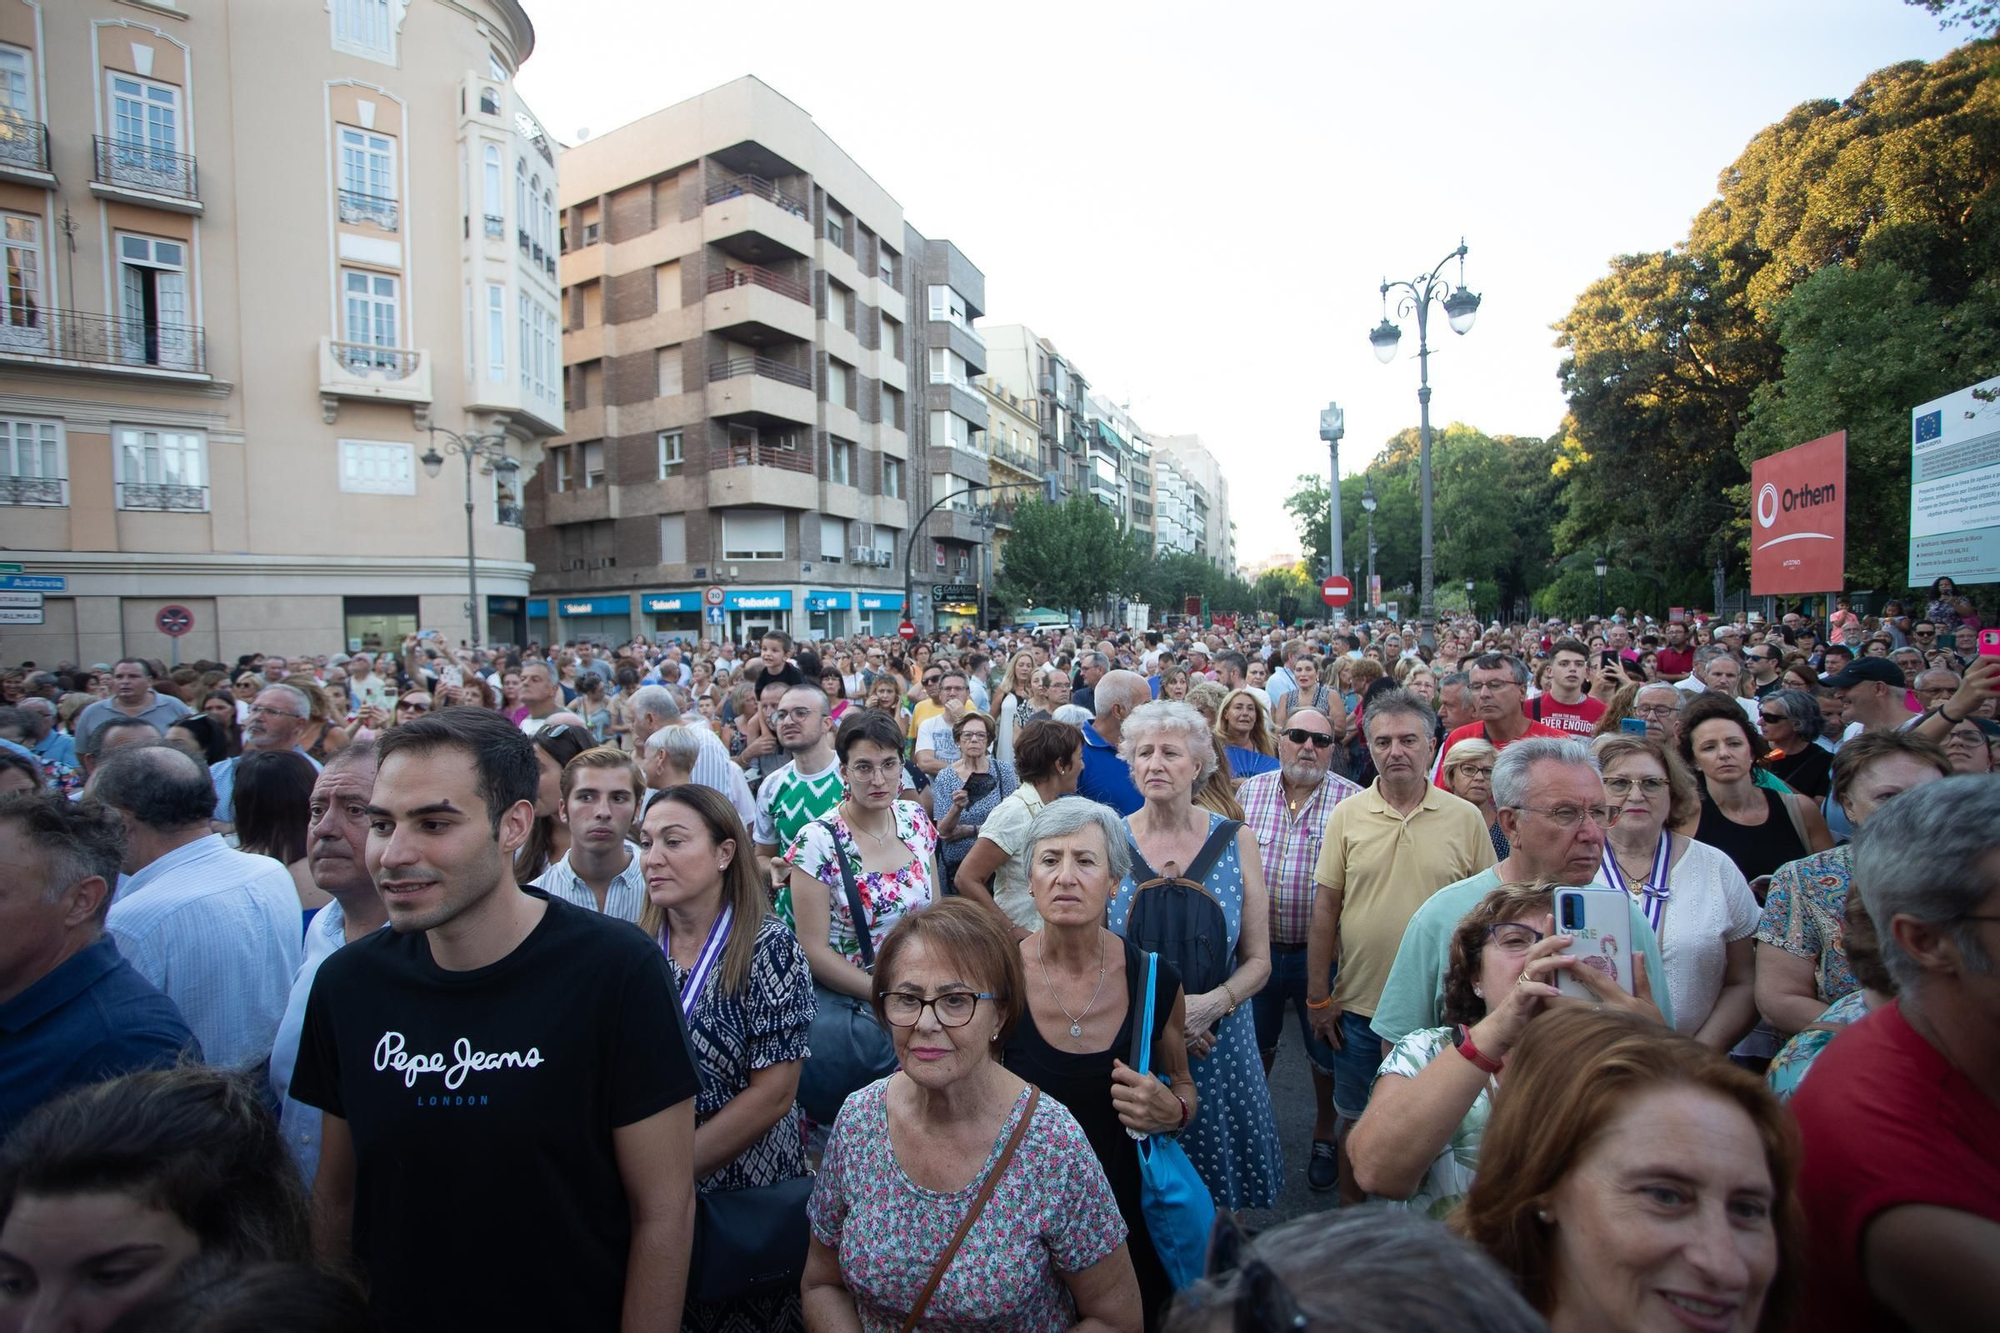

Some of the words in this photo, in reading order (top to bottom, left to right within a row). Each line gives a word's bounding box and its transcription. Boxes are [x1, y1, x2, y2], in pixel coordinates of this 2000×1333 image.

[1782, 484, 1835, 512] Orthem
[652, 599, 681, 610] Sabadell
[738, 597, 780, 608] Sabadell
[374, 1031, 446, 1088] Pepe
[445, 1037, 544, 1089] Jeans
[417, 1096, 489, 1106] LONDON
